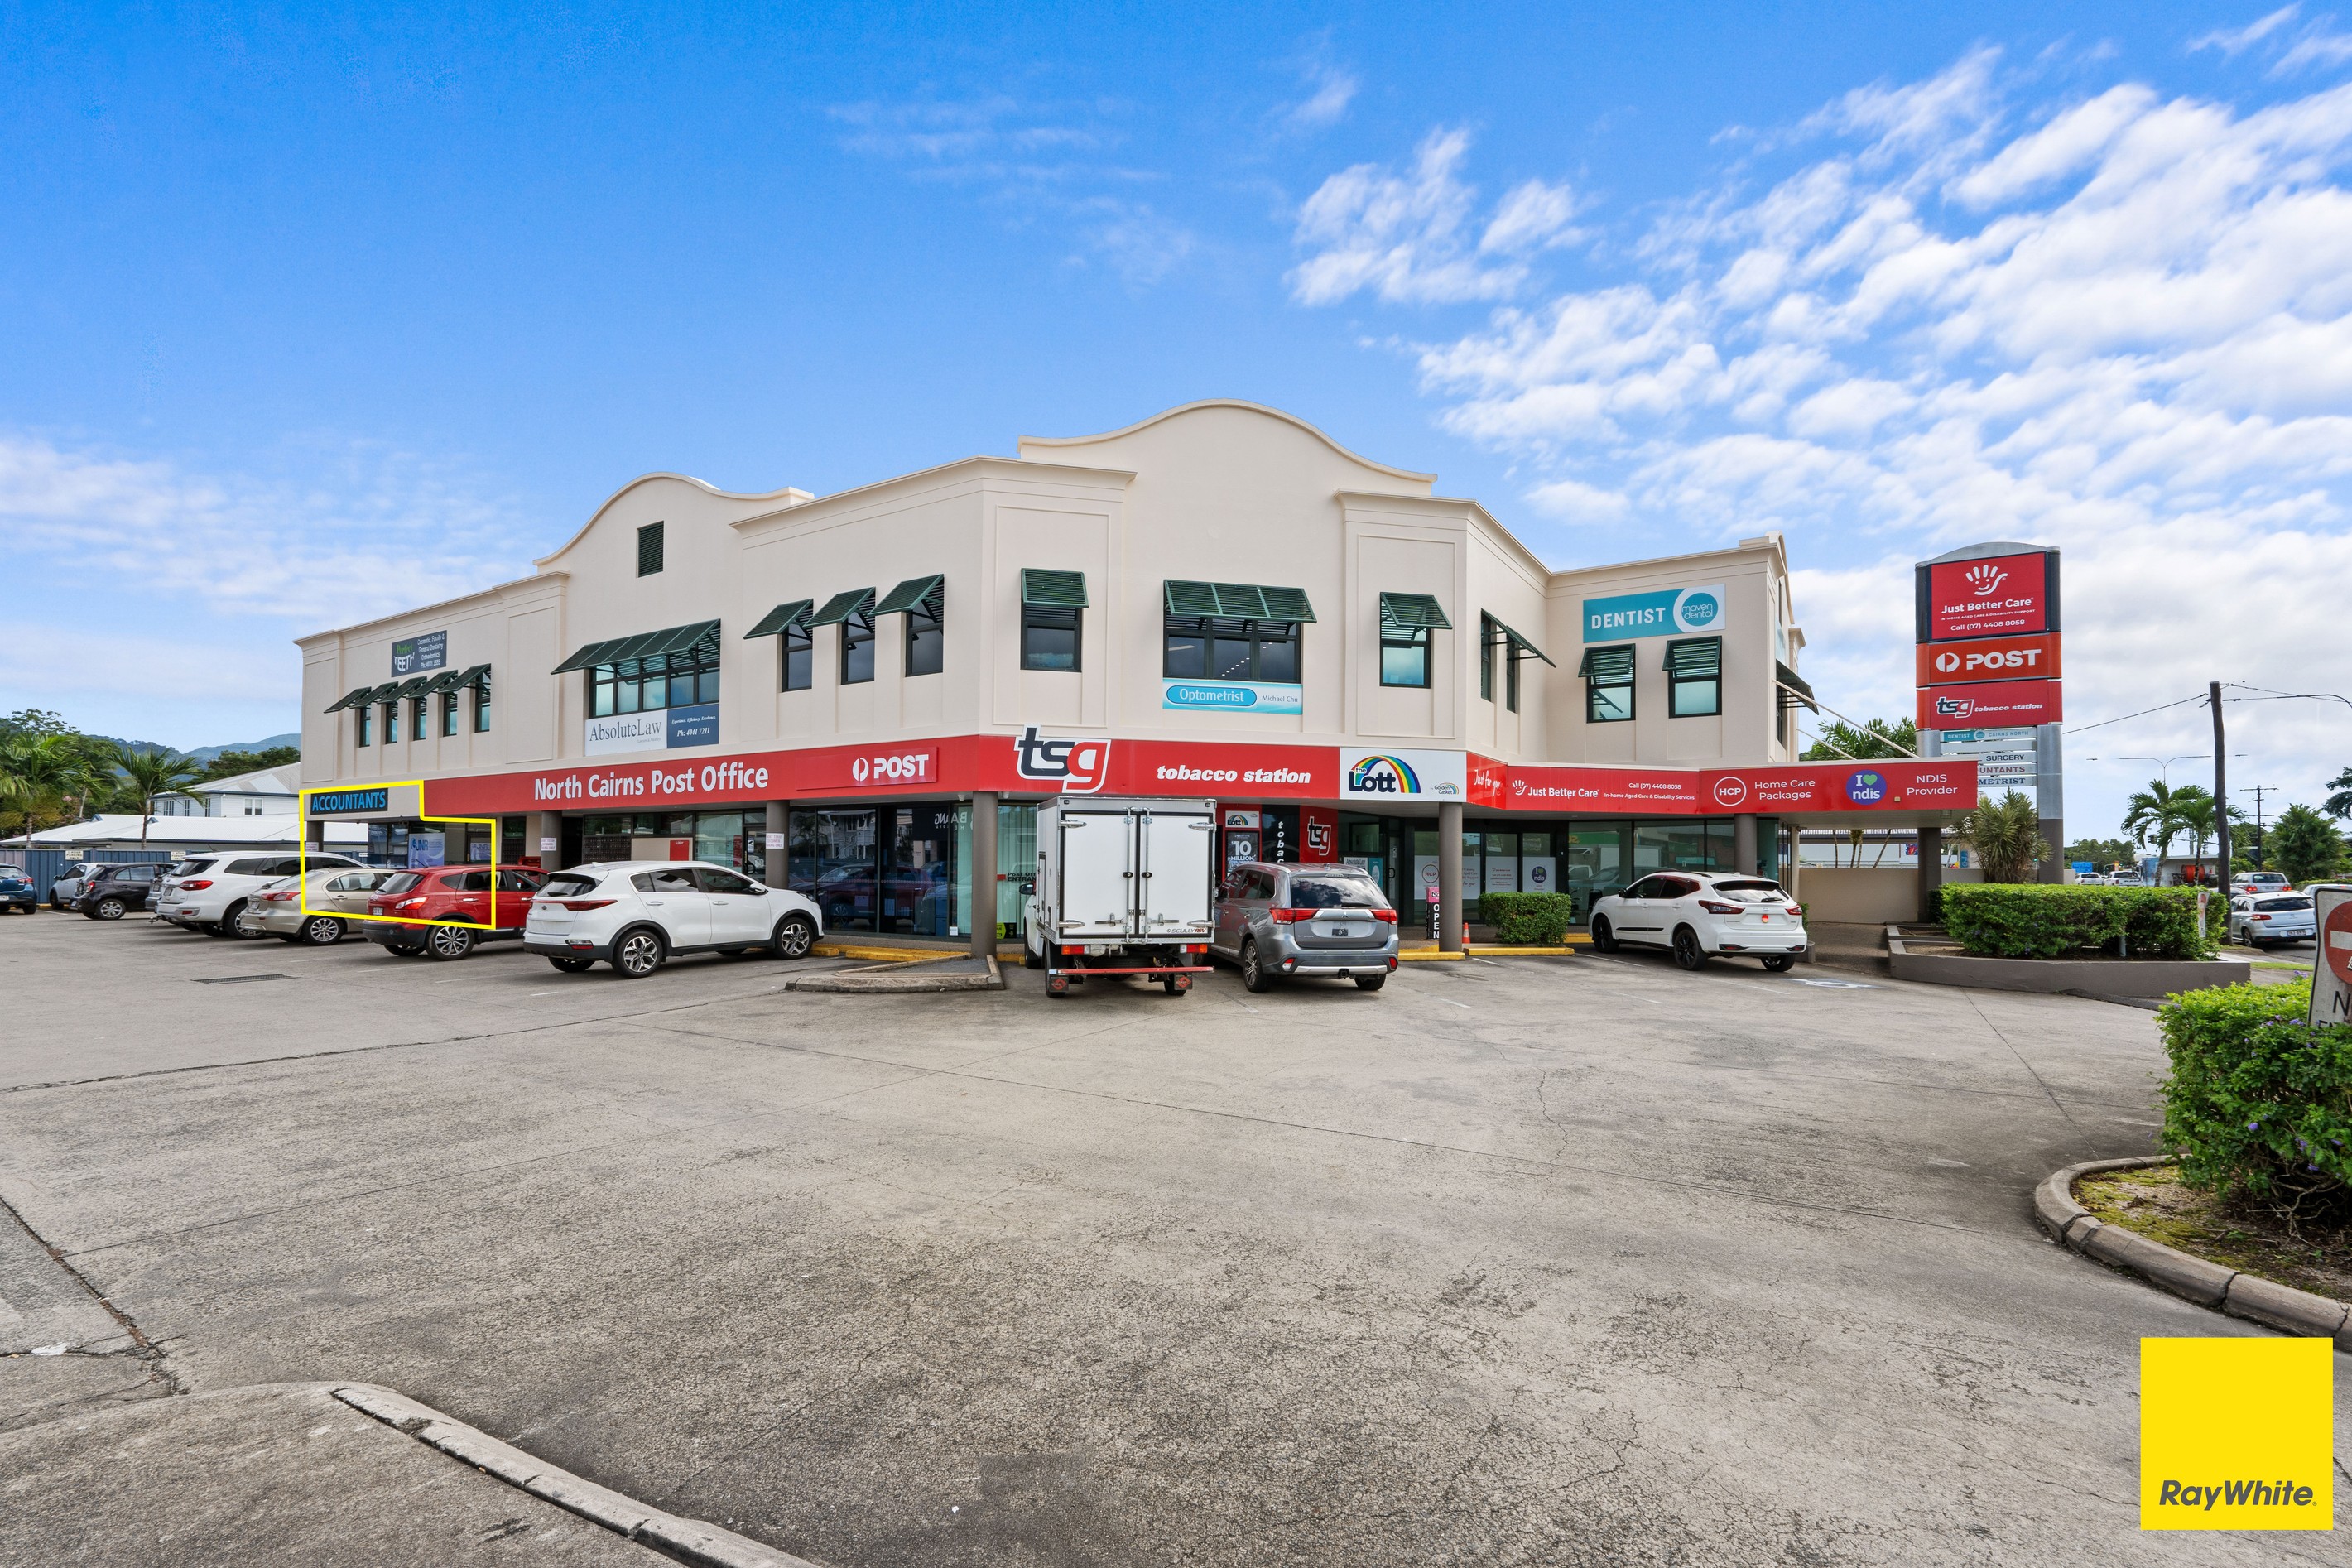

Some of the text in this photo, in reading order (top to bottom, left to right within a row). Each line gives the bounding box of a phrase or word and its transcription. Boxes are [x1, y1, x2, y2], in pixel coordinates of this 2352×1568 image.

[1681, 603, 1713, 612] maven
[1684, 611, 1713, 619] dental
[1941, 598, 2032, 613] Just Better Care
[1591, 608, 1666, 629] DENTIST
[1967, 623, 1981, 631] (07)
[1966, 648, 2042, 671] POST
[1179, 688, 1244, 703] Optometrist
[1936, 696, 1974, 719] tsg
[589, 719, 662, 742] AbsoluteLaw
[873, 754, 929, 778] POST
[1014, 723, 1111, 794] tsg
[535, 762, 768, 801] North Cairns Post Office
[1157, 764, 1311, 784] tobacco station
[1349, 771, 1396, 792] Lott
[1474, 769, 1484, 786] Just
[1492, 779, 1502, 796] you
[1790, 779, 1816, 787] Care
[1917, 774, 1947, 784] NDIS
[1978, 777, 2026, 786] METRIST
[312, 791, 386, 811] ACCOUNTANTS
[1527, 787, 1598, 797] Just Better Care
[1759, 791, 1811, 801] Packages
[1853, 788, 1880, 800] ndis
[1907, 786, 1958, 796] Provider
[1277, 820, 1285, 863] tobac
[1308, 816, 1331, 855] tsg
[1231, 840, 1252, 856] $10
[2333, 991, 2351, 1016] N
